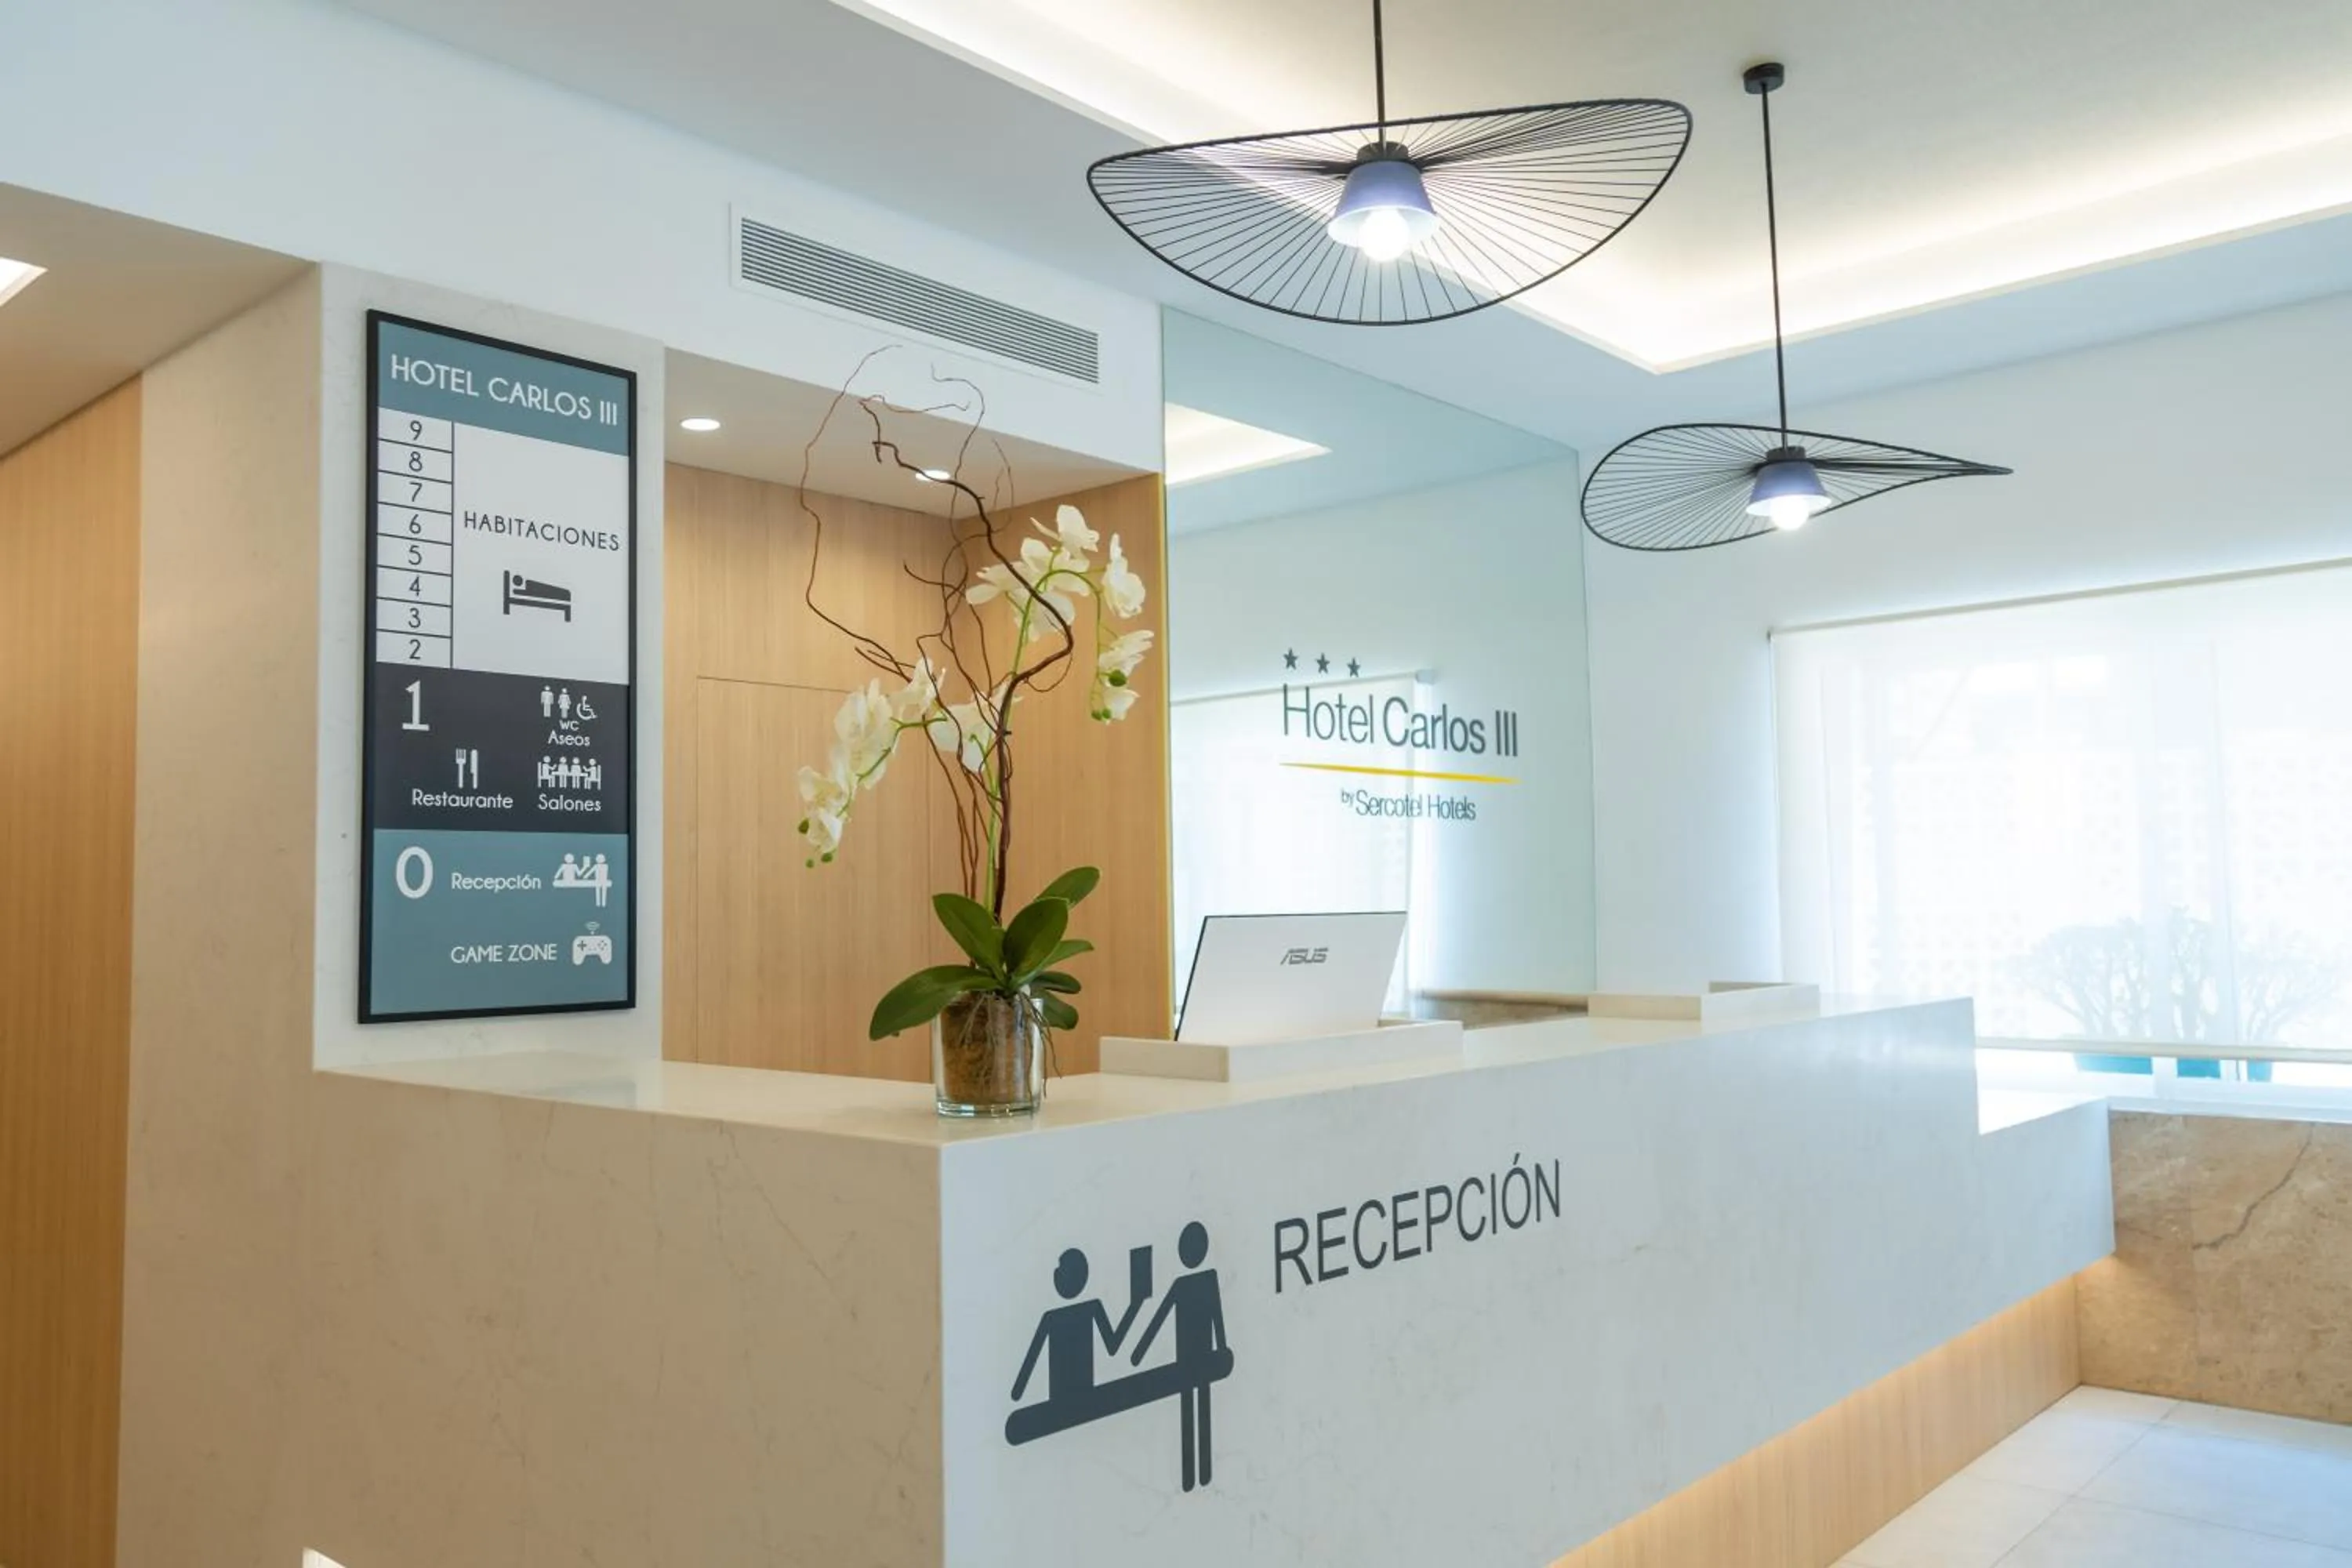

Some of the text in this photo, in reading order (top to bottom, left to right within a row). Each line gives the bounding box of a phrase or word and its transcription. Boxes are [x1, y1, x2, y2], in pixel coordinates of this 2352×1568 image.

[392, 354, 618, 426] HOTEL CARLOS III
[409, 420, 423, 441] 9
[409, 451, 423, 472] 8
[408, 482, 423, 503] 7
[409, 514, 422, 535] 6
[464, 511, 619, 551] HABITACIONES
[408, 545, 422, 566] 5
[409, 576, 421, 597] 4
[408, 608, 421, 629] 3
[409, 639, 421, 660] 2
[402, 680, 430, 731] 1
[1283, 684, 1518, 757] Hotel Carlos III
[548, 731, 590, 747] Aseos
[412, 789, 514, 809] Restaurante
[538, 793, 601, 812] Salones
[1341, 789, 1476, 820] by Sercotel Hotels
[452, 873, 541, 893] Recepción
[451, 943, 557, 964] GAME ZONE
[1280, 947, 1328, 966] ASUS
[1275, 1152, 1561, 1294] RECEPCIÓN
